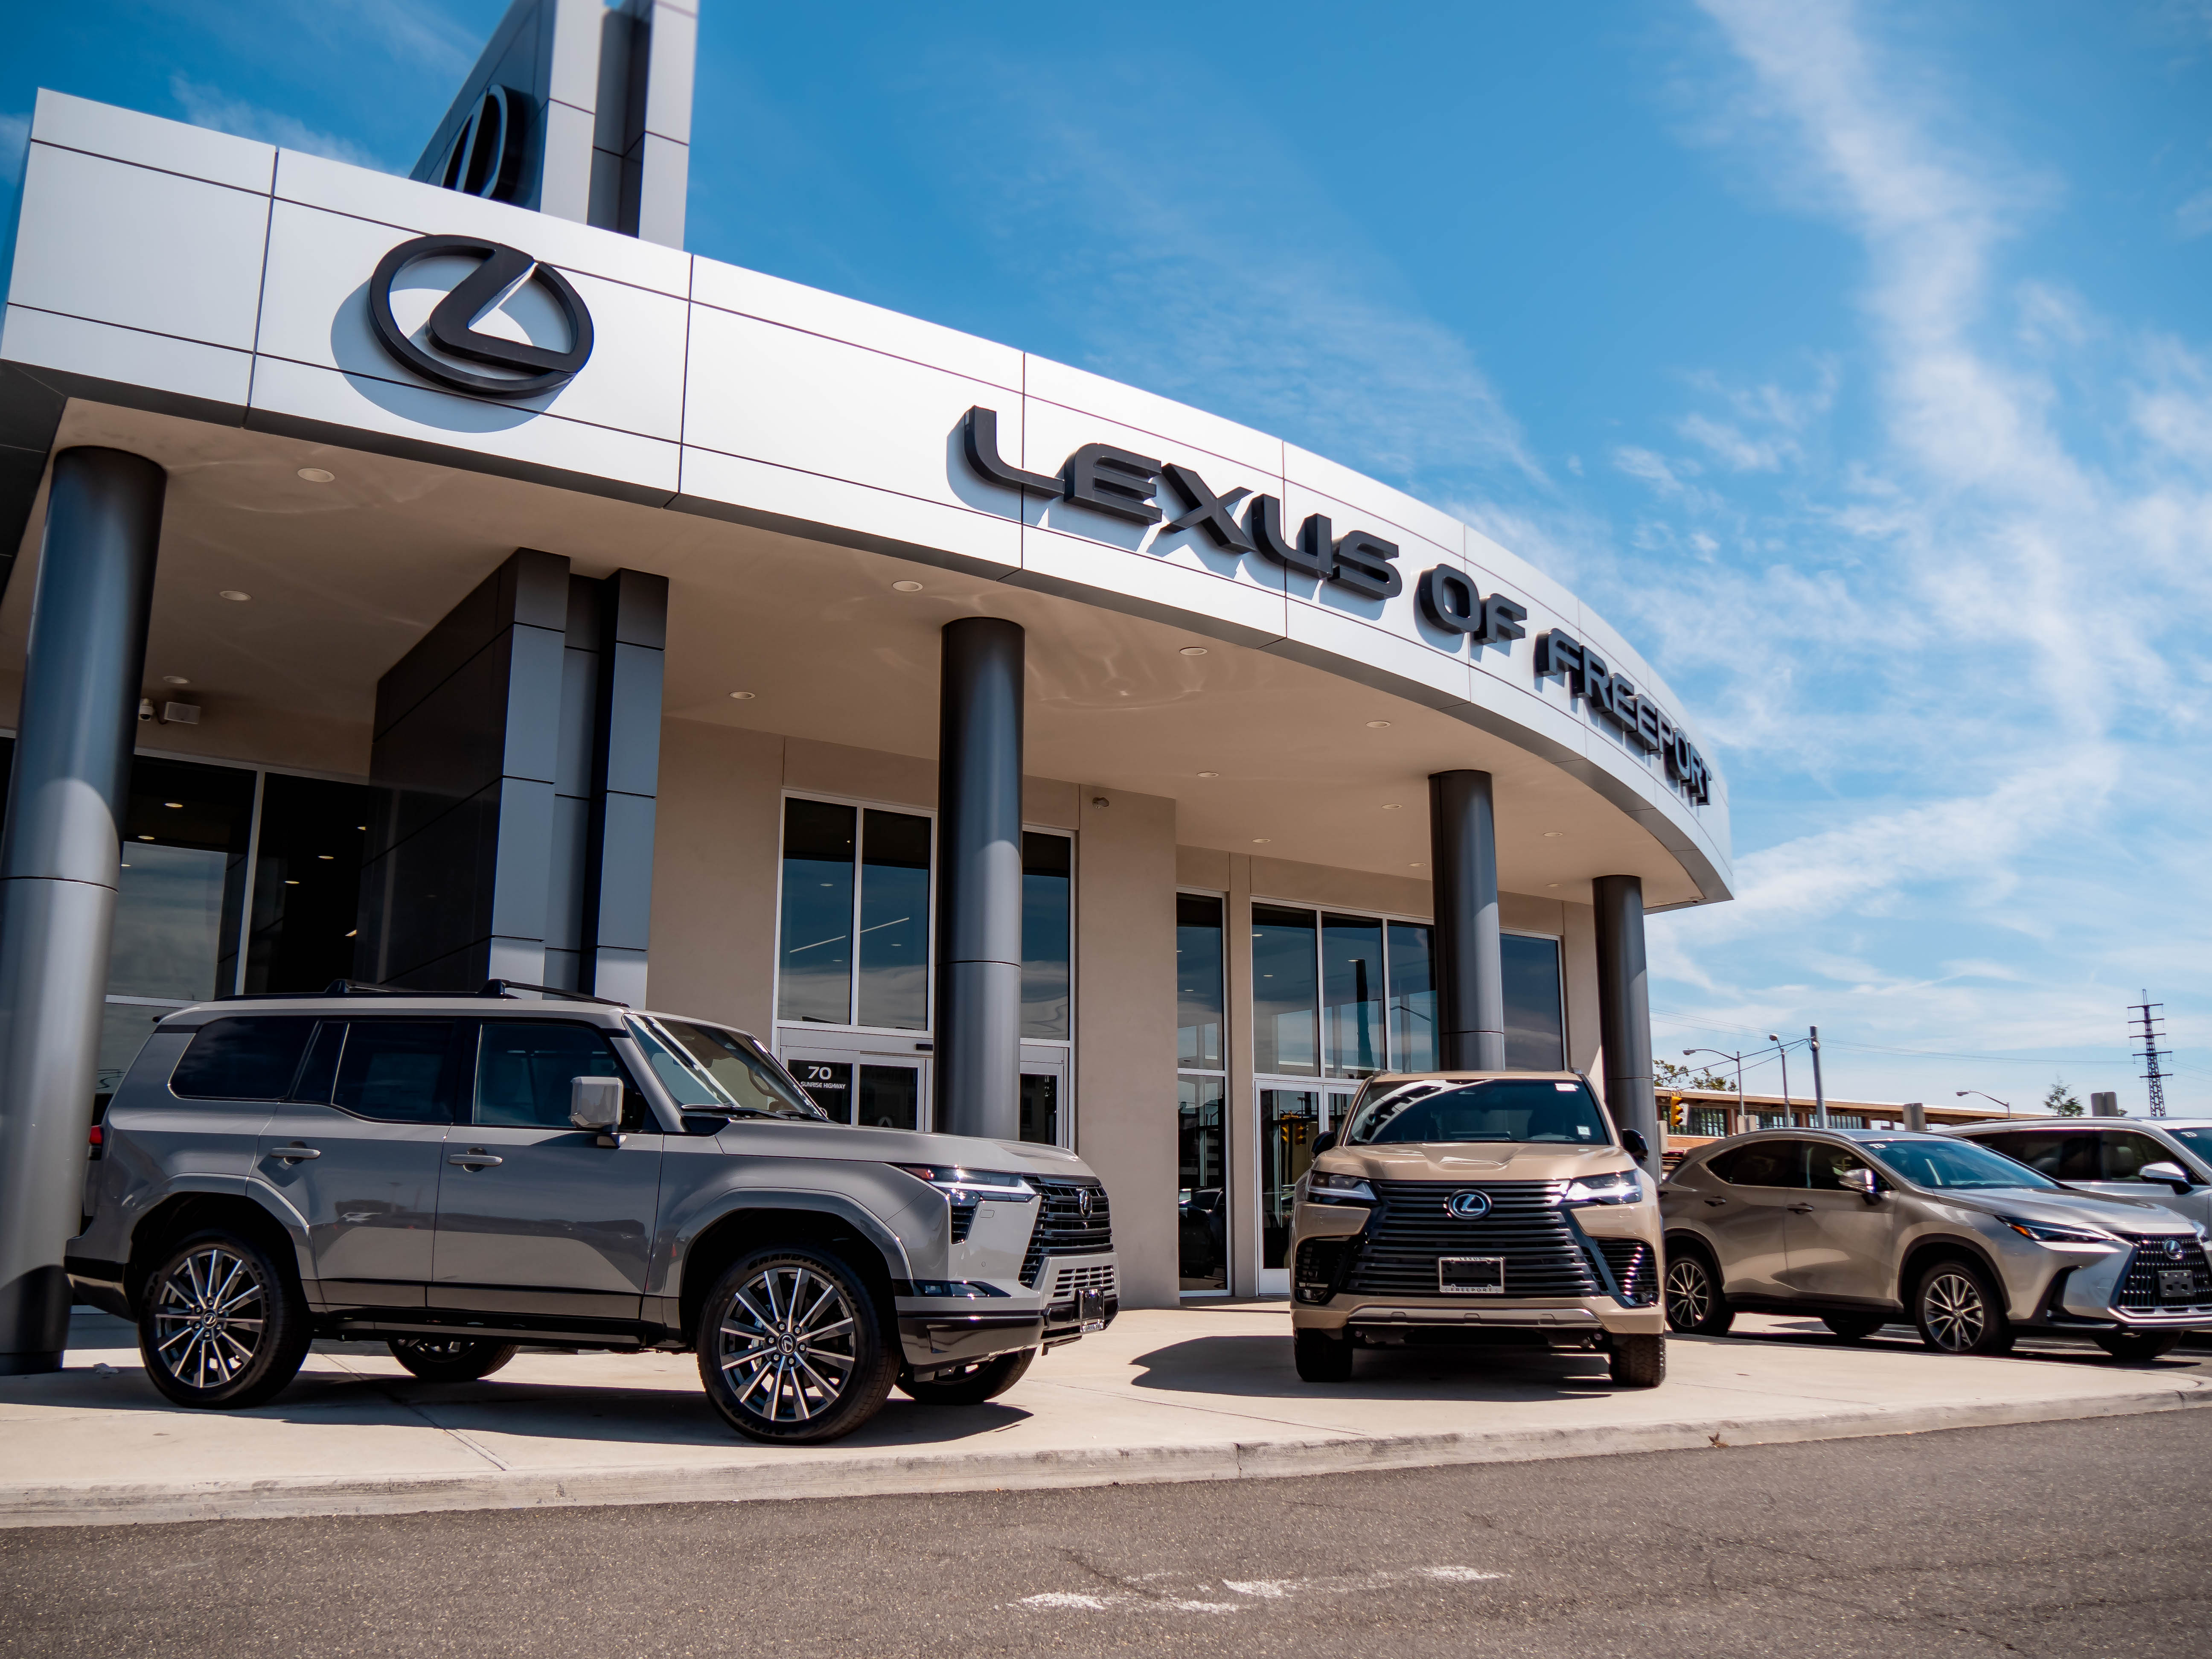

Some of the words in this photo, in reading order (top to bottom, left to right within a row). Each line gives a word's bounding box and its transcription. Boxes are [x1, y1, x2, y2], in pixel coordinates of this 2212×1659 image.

[963, 405, 1401, 601] LEXUS
[1419, 564, 1528, 644] OF
[1536, 627, 1712, 806] FREEPORT
[808, 1066, 832, 1080] 70
